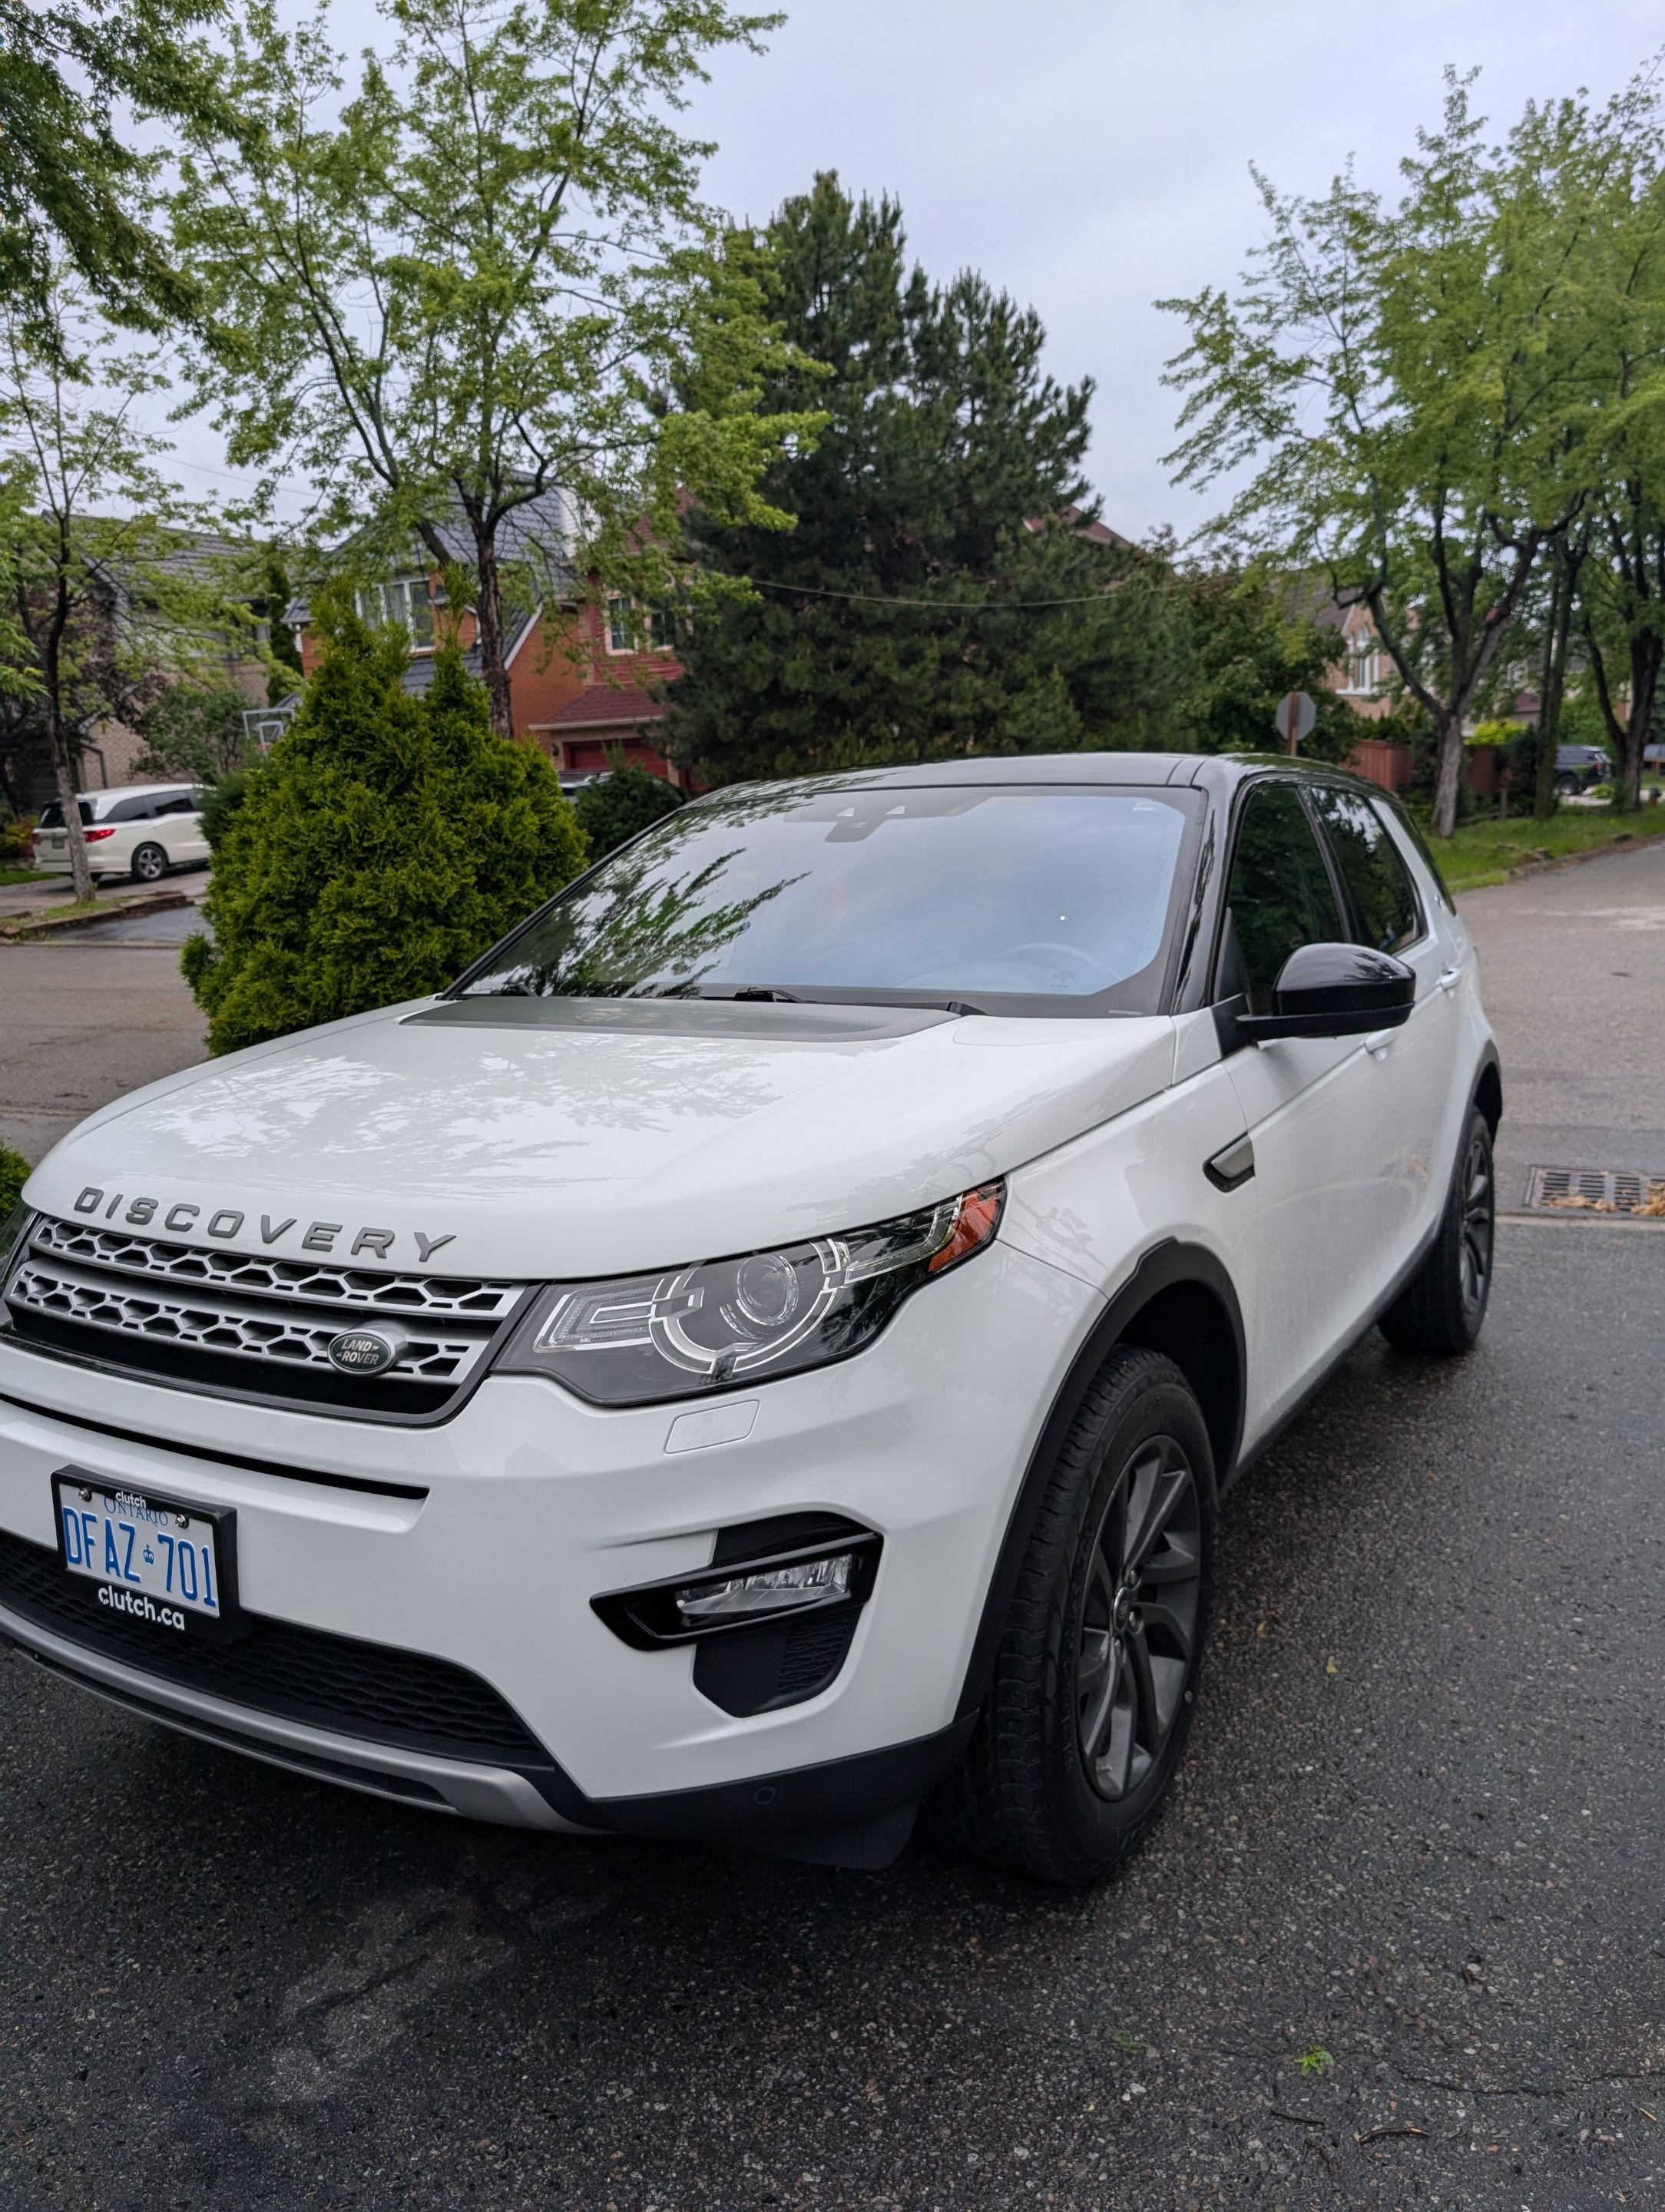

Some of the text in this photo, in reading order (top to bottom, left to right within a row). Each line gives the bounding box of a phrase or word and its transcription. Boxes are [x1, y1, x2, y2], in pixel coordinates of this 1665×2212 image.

[74, 1187, 457, 1262] DISCOVERY
[341, 1339, 372, 1352] LAND
[341, 1351, 379, 1365] ROVER
[104, 1496, 168, 1528] ONTARIO
[115, 1491, 147, 1509] clutch
[62, 1505, 217, 1608] DFAZ 701
[98, 1585, 185, 1631] clutch.ca
